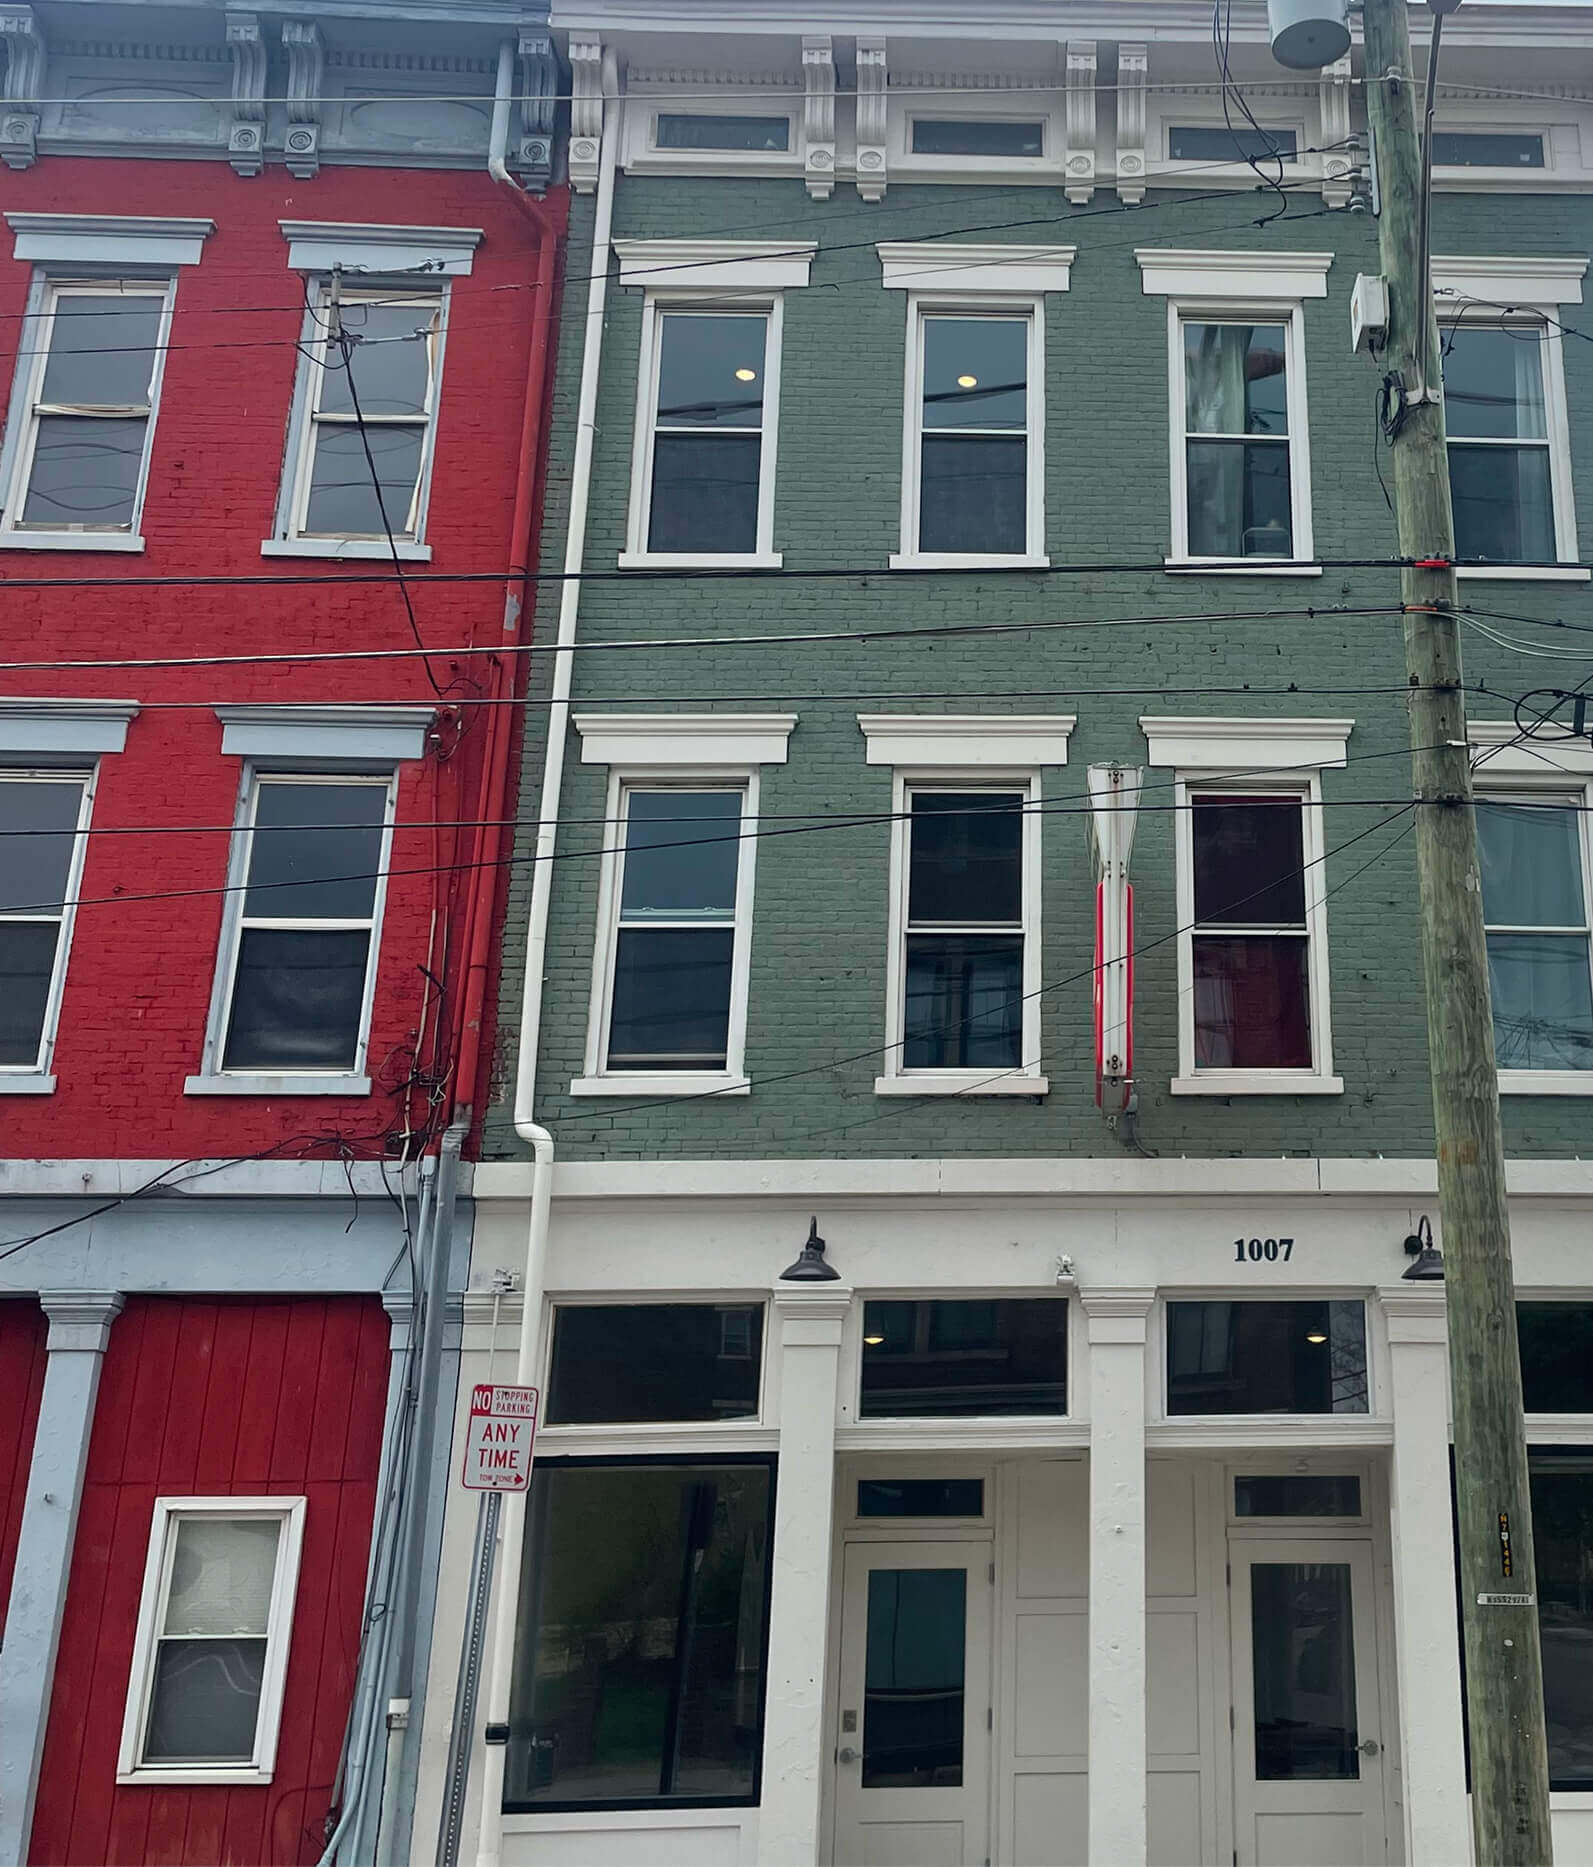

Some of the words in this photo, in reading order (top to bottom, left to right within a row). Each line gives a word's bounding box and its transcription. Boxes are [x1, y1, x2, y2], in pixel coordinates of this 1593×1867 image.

[1234, 1239, 1294, 1262] 1007
[472, 1391, 492, 1410] NO
[495, 1390, 534, 1402] STOPPING
[496, 1402, 531, 1414] PARKING
[482, 1423, 520, 1443] ANY
[479, 1449, 520, 1469] TIME
